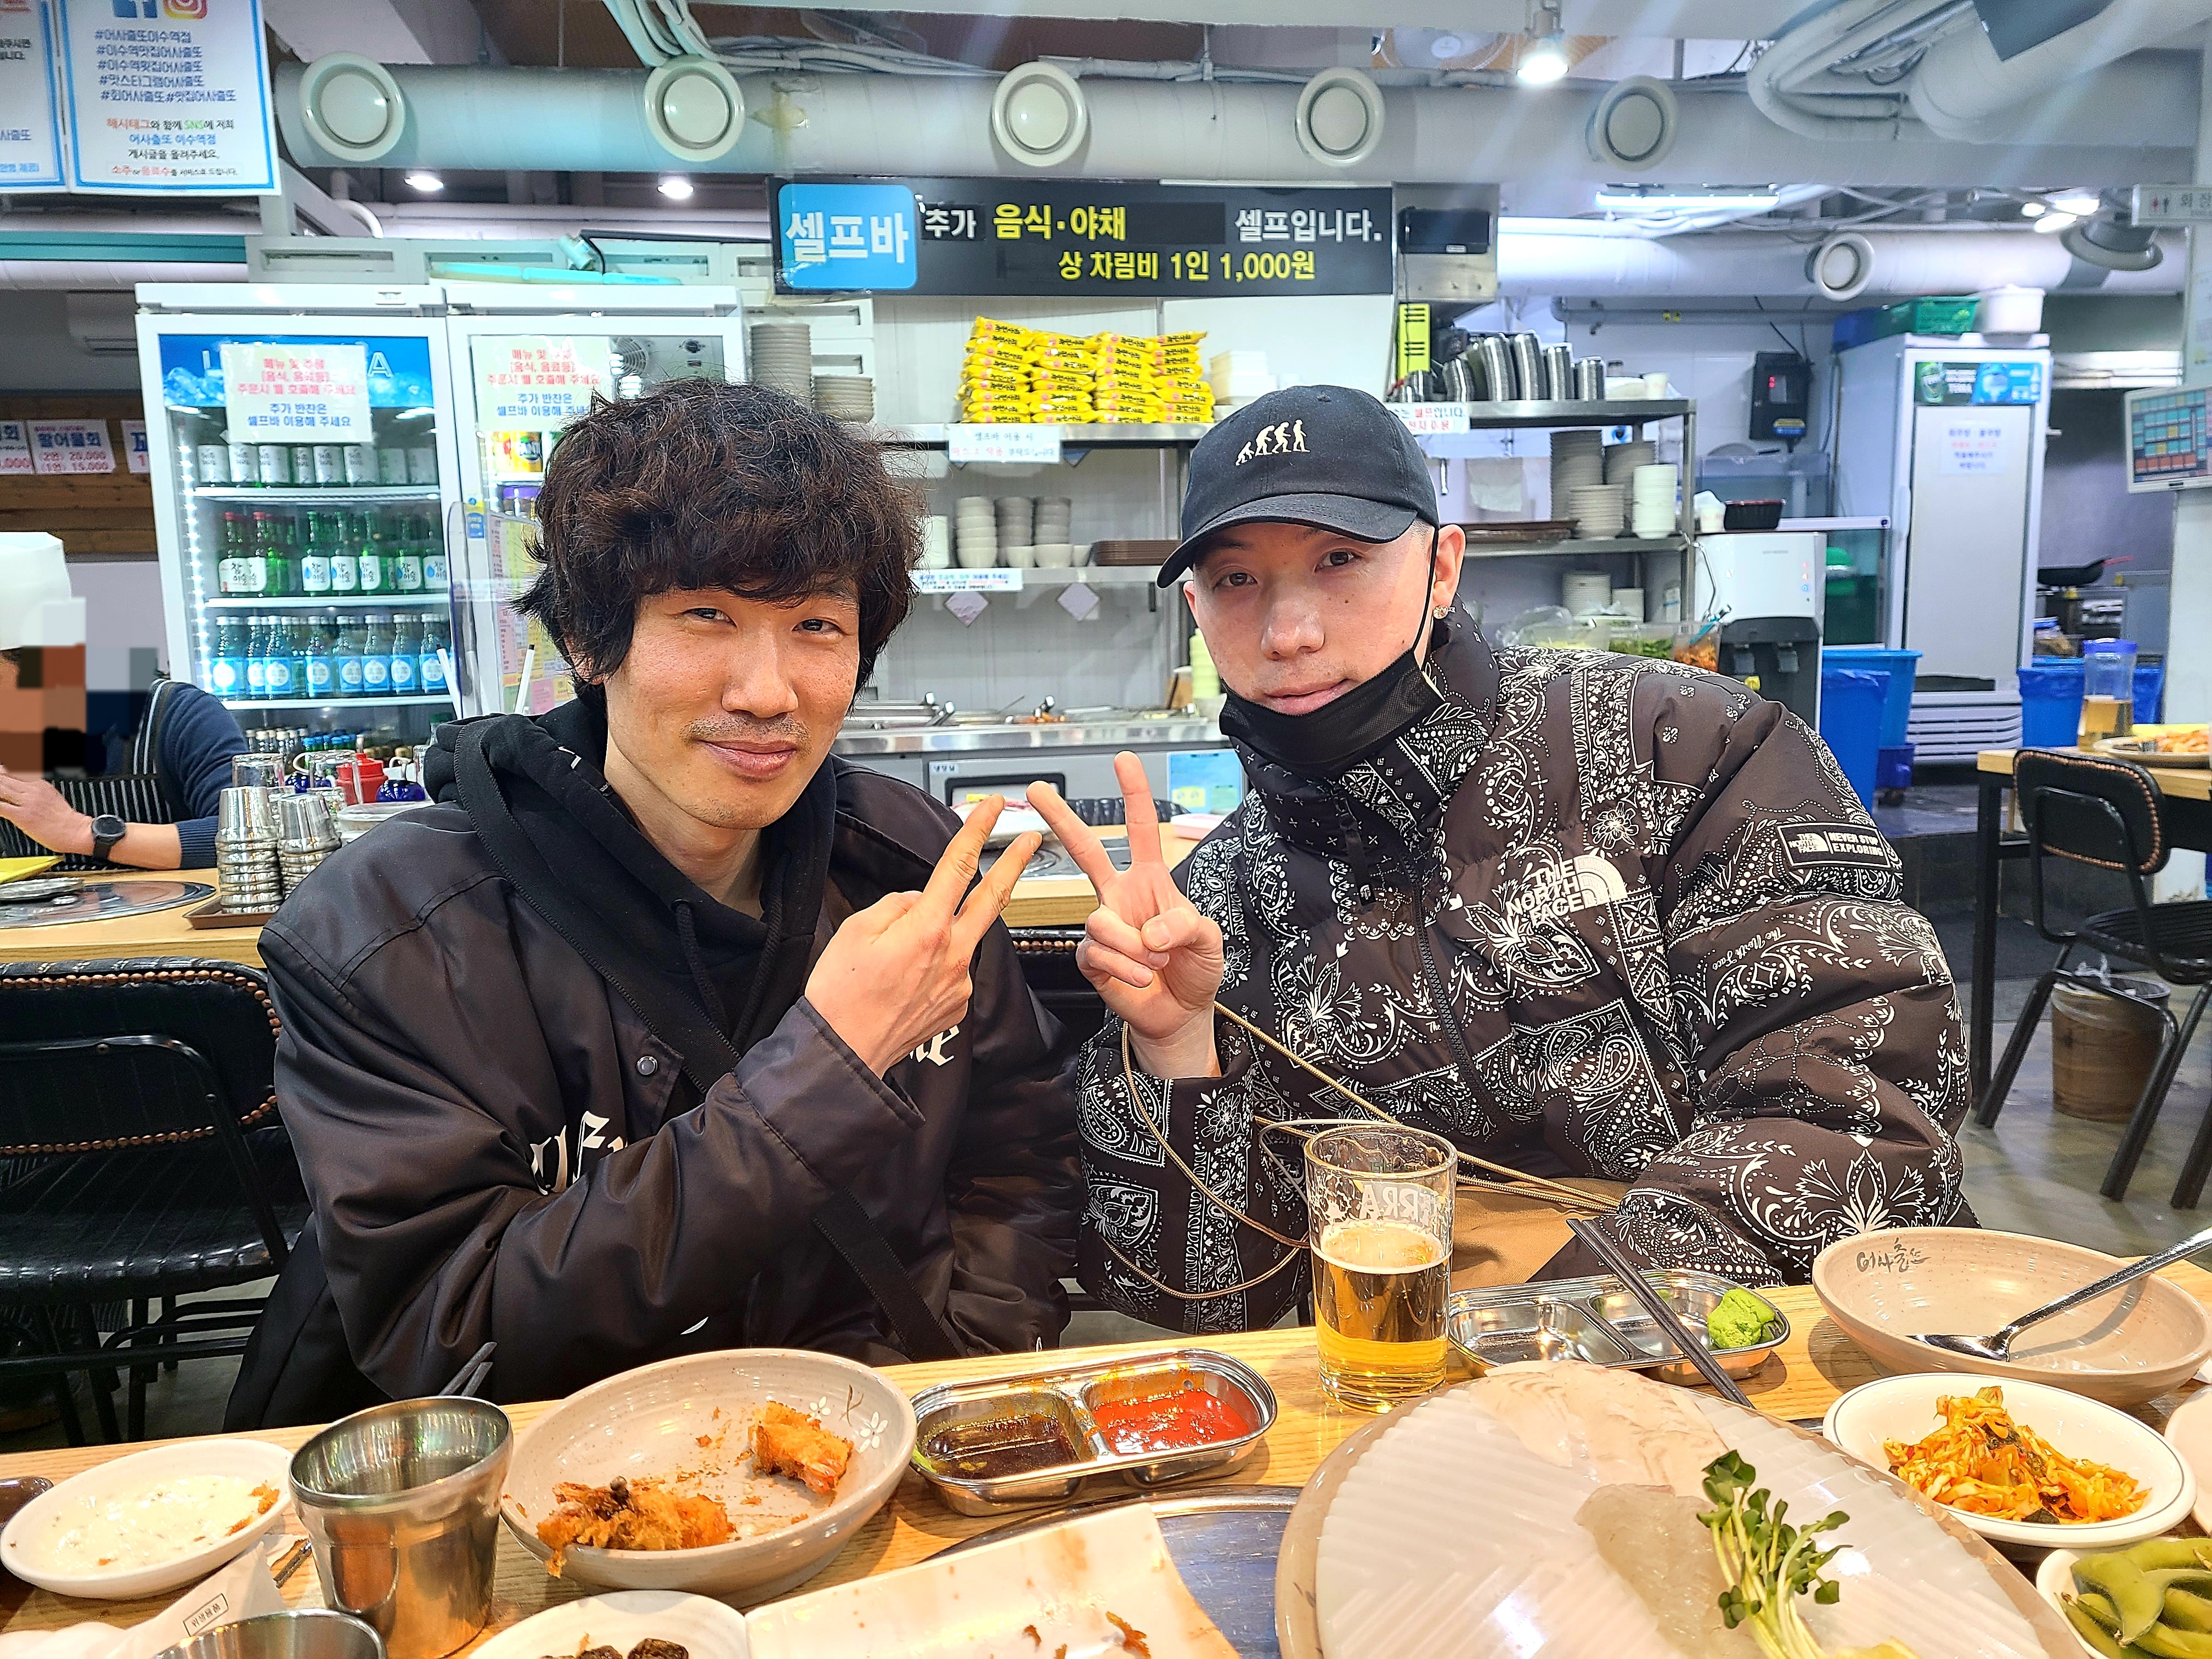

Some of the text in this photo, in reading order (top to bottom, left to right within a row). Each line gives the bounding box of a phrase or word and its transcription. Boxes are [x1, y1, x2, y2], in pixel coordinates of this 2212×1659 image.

[924, 208, 977, 240] 추가
[1235, 208, 1383, 244] 셀프입니다.
[786, 211, 909, 263] 셀프바
[1058, 251, 1316, 283] 상 차림비 1인 1,000원
[517, 393, 572, 404] 추가 반찬은
[269, 403, 327, 415] 추가 반찬은
[497, 405, 527, 416] 셀프바
[531, 406, 561, 416] 이용해
[248, 415, 351, 427] 셀프바 이용해 주세요
[1788, 840, 1815, 848] NORTH
[1828, 832, 1878, 845] NEVER STOP
[1832, 843, 1884, 856] EXPLORING
[1532, 859, 1574, 887] THE
[1506, 876, 1580, 917] NORTH
[1530, 893, 1584, 927] FACE
[1712, 927, 1787, 970] The North Face
[1425, 1021, 1442, 1034] The
